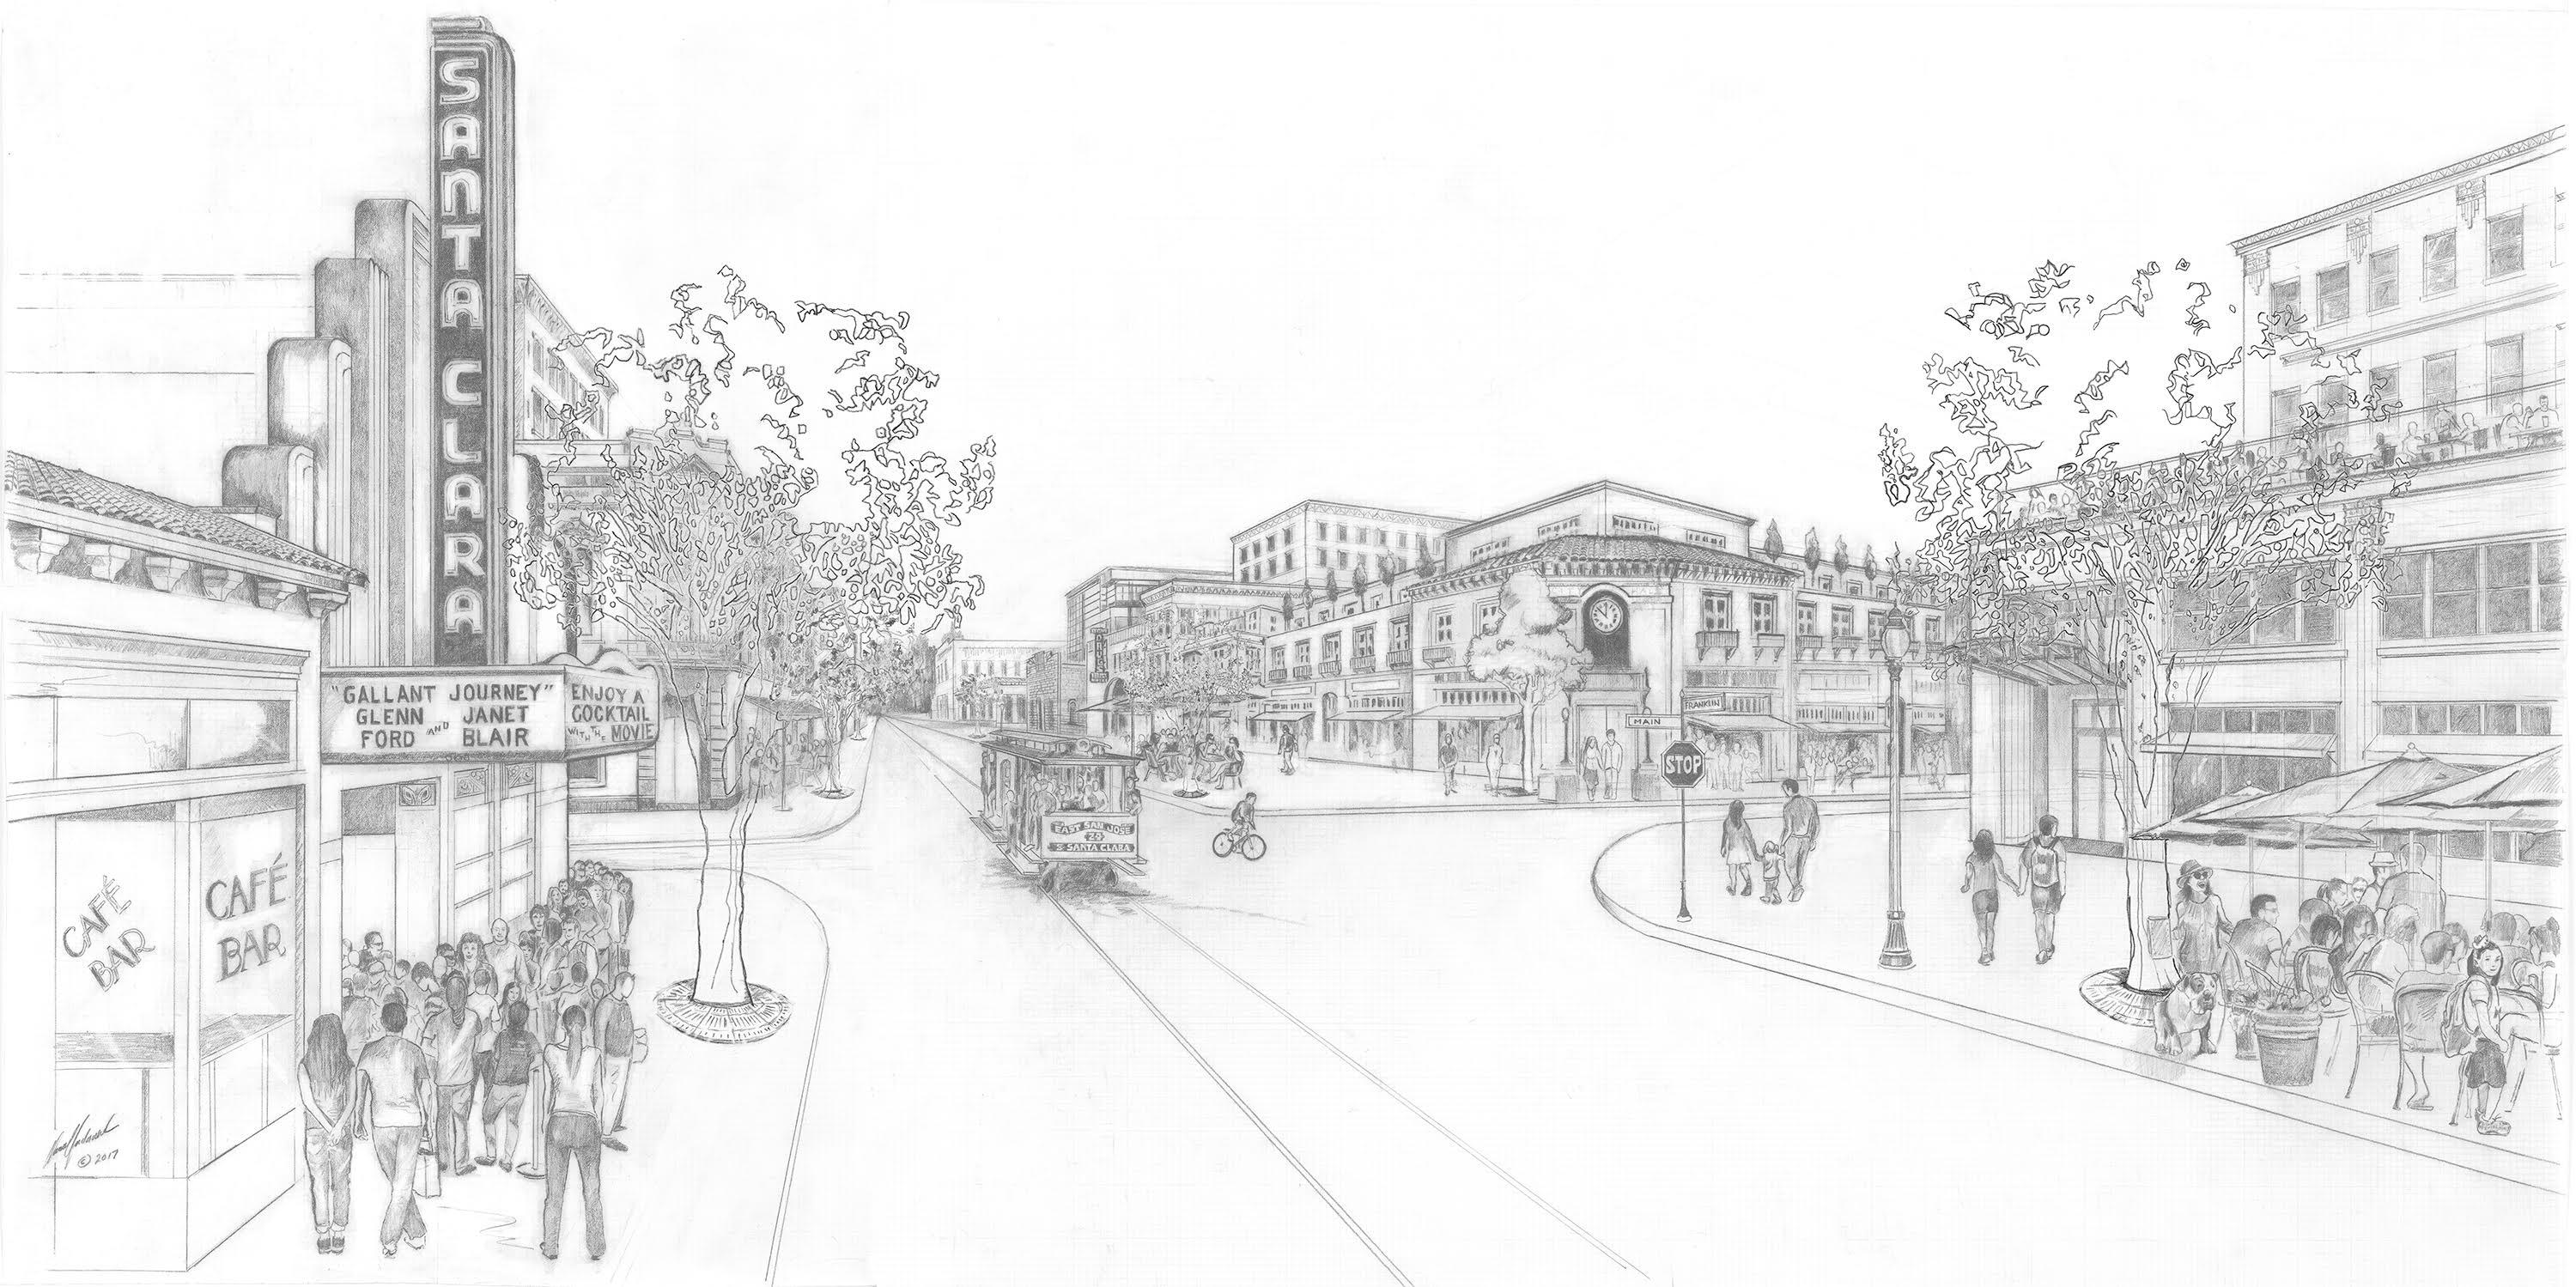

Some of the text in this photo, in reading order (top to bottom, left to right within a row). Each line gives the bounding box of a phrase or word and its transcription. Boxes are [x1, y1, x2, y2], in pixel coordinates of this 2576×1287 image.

[439, 56, 486, 634] SANTA CLARA
[571, 683, 645, 704] ENJOY A
[571, 704, 650, 723] COCKTAIL
[1684, 700, 1720, 709] FRANKLIN
[355, 705, 530, 725] GLENN JANET
[361, 721, 530, 749] FORD AND BLAIR
[568, 724, 655, 743] WITH THE MOVIE
[1665, 755, 1702, 774] STOP
[1054, 821, 1131, 835] EAST SAN JOSE
[1066, 843, 1098, 852] SANTA
[1099, 843, 1131, 852] CLARA
[204, 852, 289, 920] CAFÉ
[88, 928, 156, 993] BAR
[216, 923, 287, 983] BAR
[94, 1149, 119, 1164] 2017
